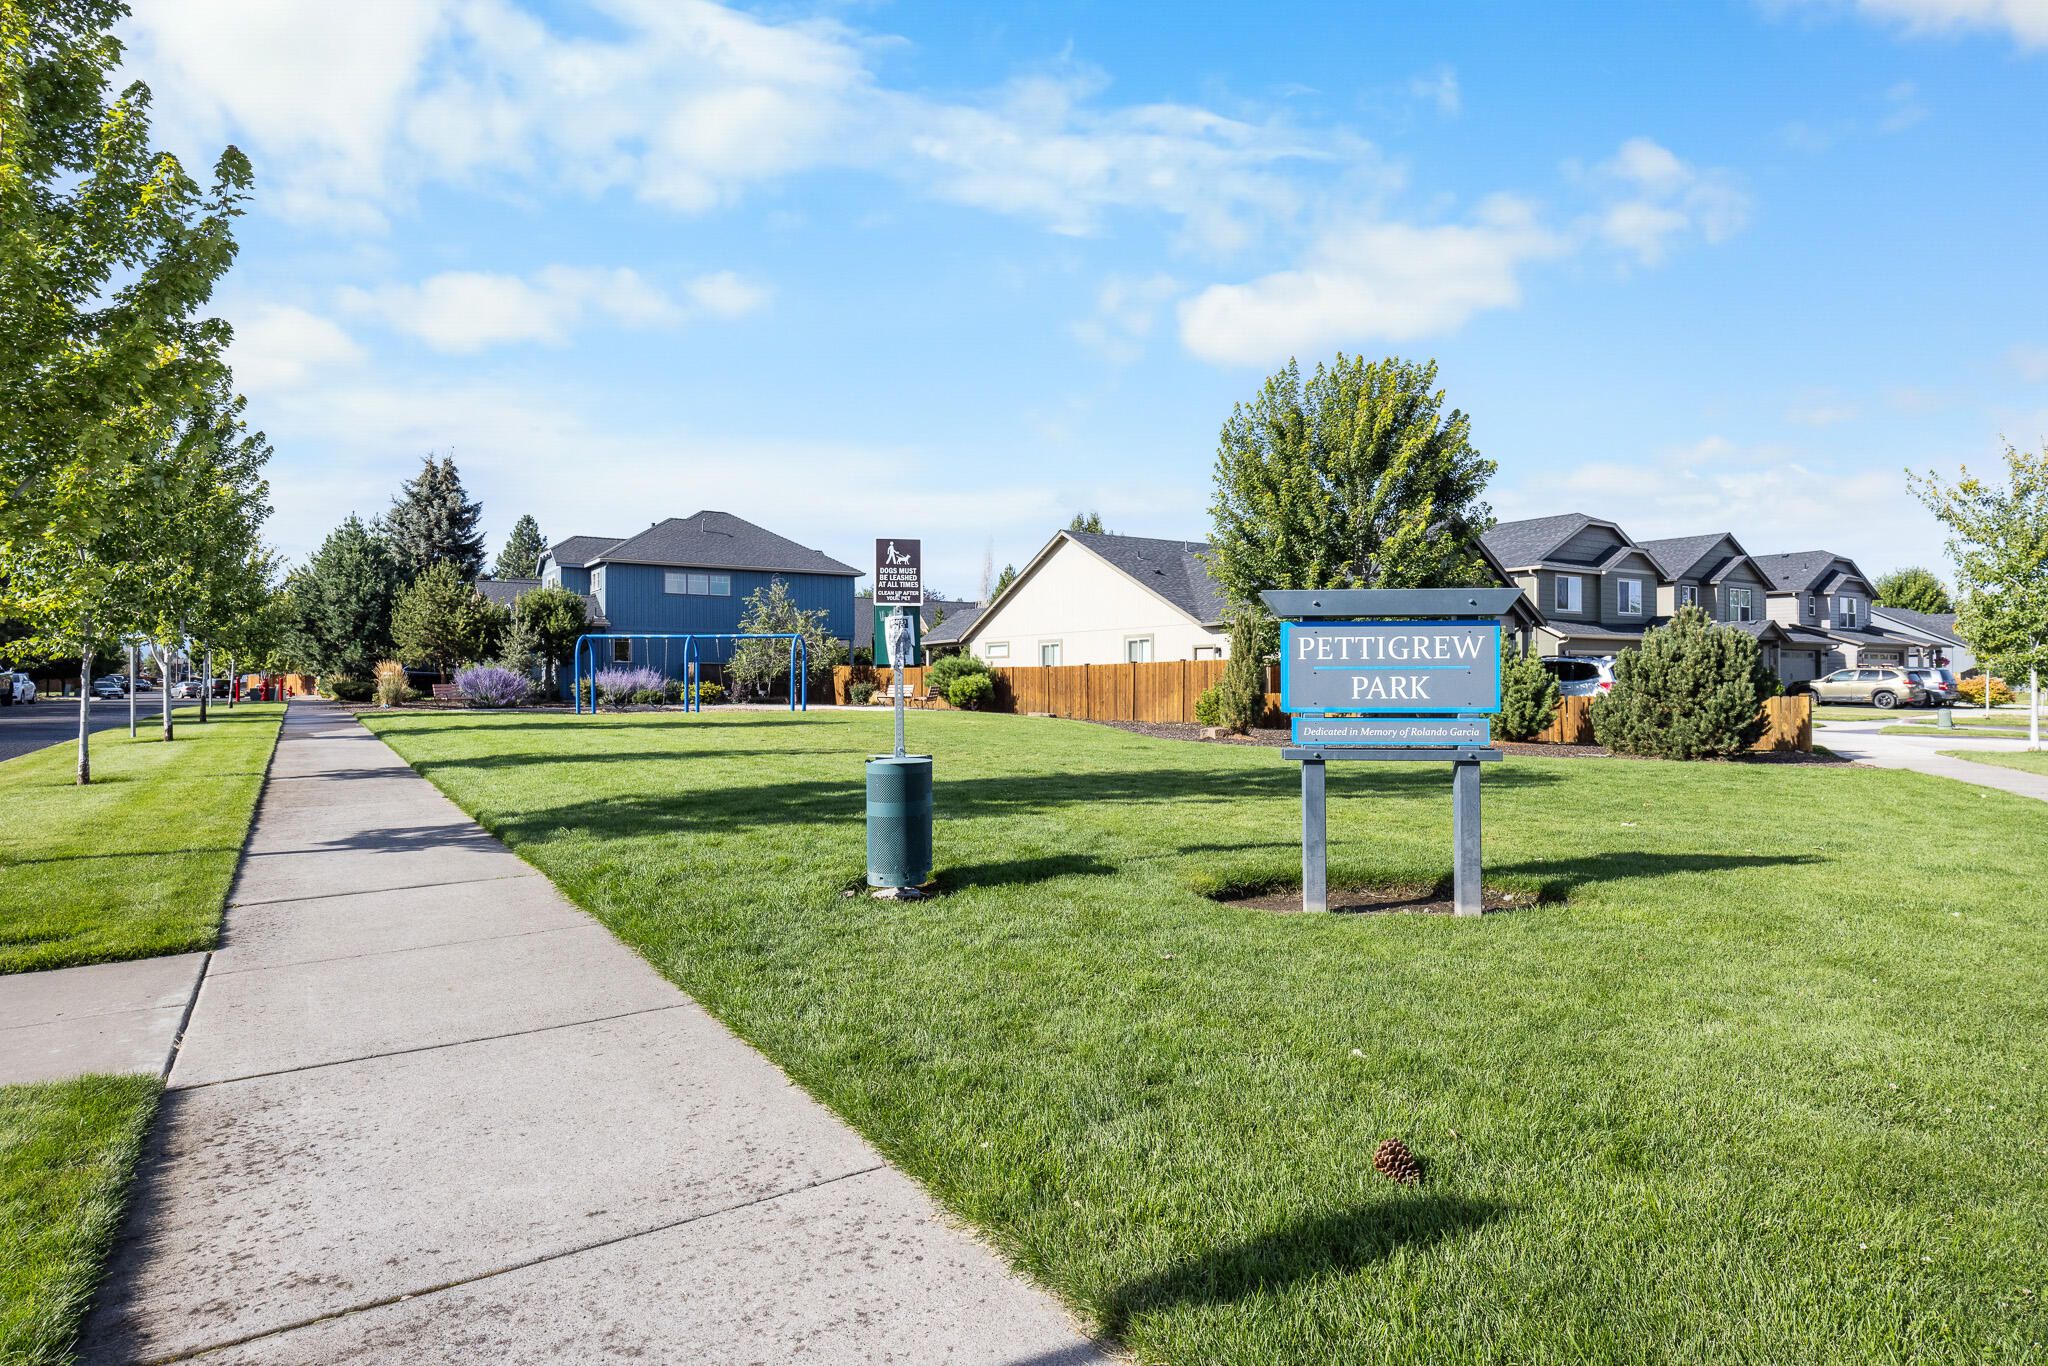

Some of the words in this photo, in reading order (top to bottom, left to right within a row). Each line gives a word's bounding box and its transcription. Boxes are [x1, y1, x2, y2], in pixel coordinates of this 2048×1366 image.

[1298, 636, 1485, 660] PETTIGREW
[1351, 676, 1430, 700] PARK
[1304, 727, 1347, 737] Dedicated
[1350, 728, 1358, 736] in
[1360, 727, 1397, 739] Memory
[1399, 727, 1411, 740] of
[1411, 727, 1447, 737] Rolando
[1450, 727, 1480, 737] Garcia
